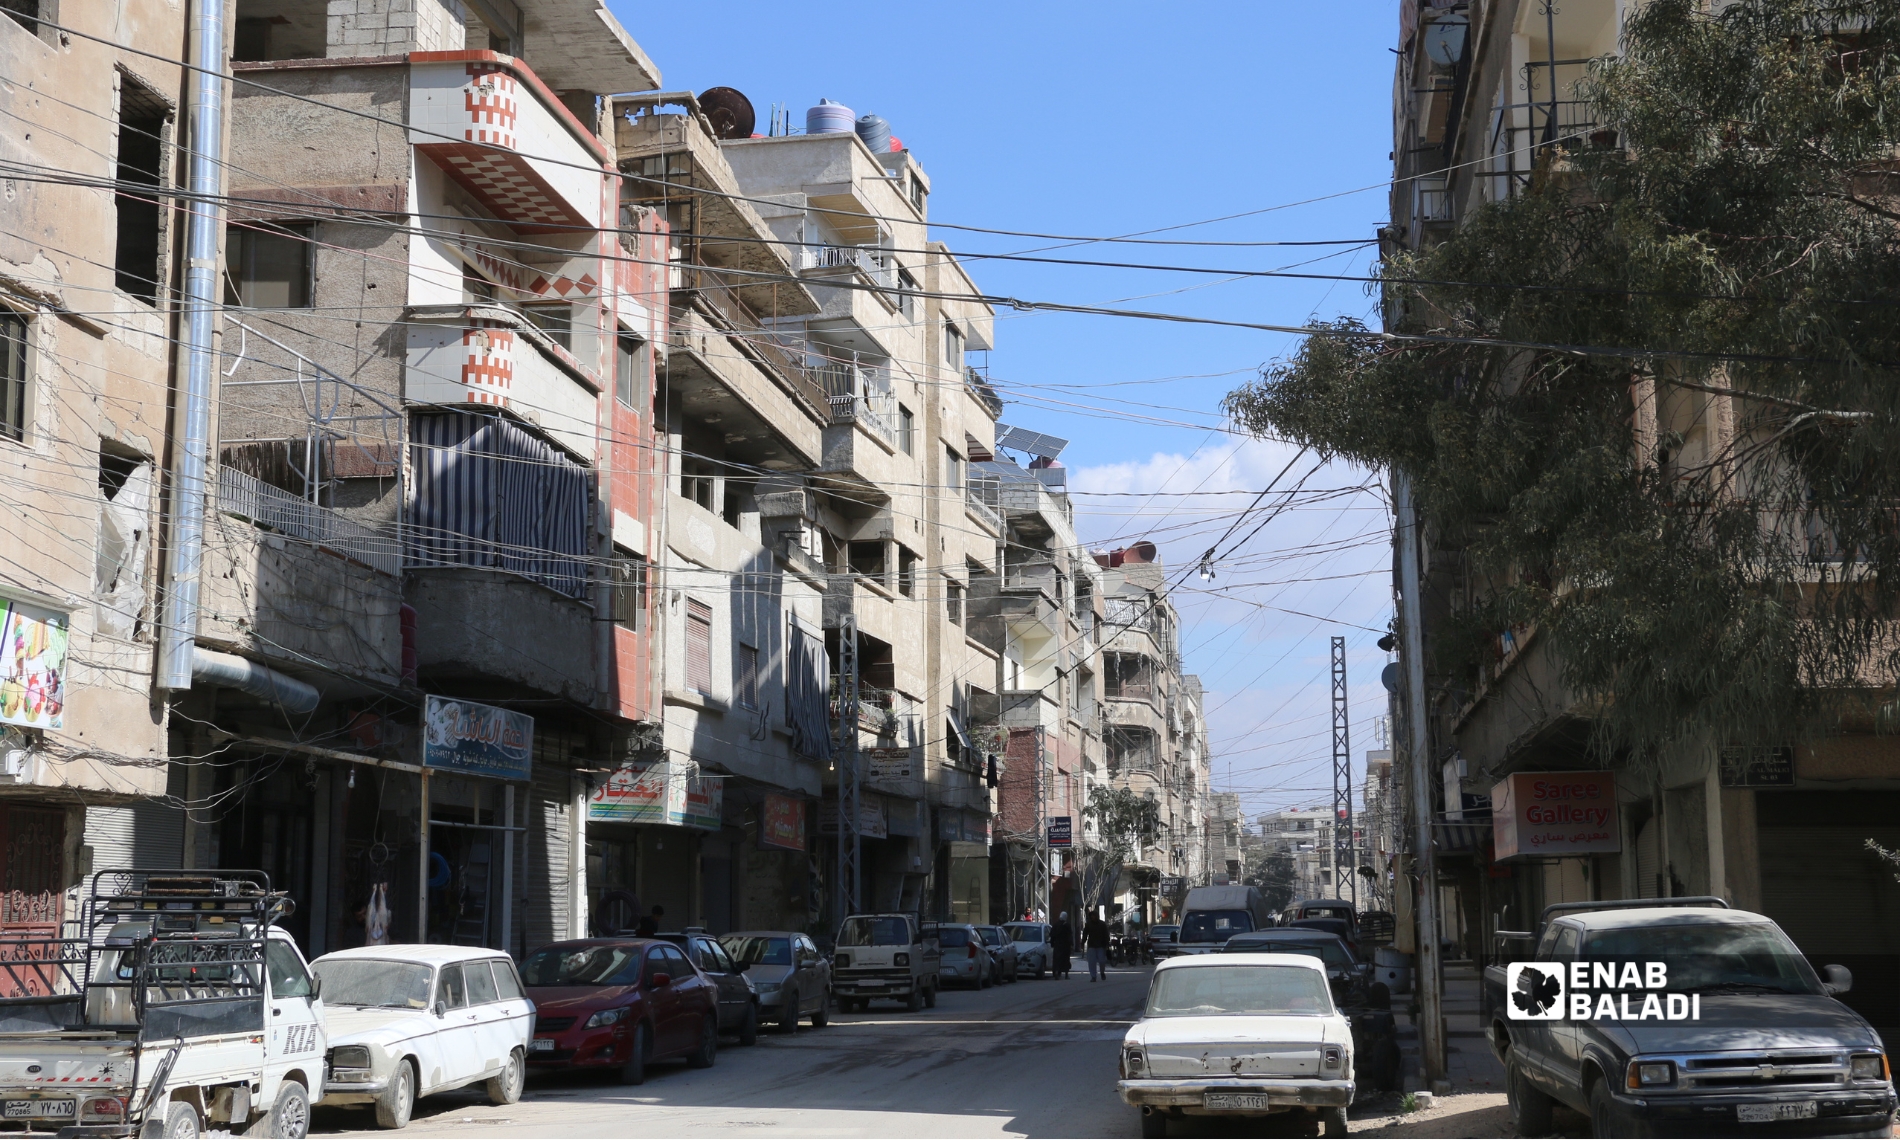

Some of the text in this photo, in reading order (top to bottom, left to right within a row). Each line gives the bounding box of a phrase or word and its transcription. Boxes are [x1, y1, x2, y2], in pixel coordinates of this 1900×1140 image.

[452, 706, 502, 752] الباشا
[592, 778, 663, 801] المختار
[1533, 780, 1600, 800] Saree
[1526, 804, 1610, 828] Gallery
[1531, 830, 1610, 847] معرض ساري
[283, 1024, 318, 1055] KIA
[6, 1100, 74, 1115] دمشق ٧٧٠٨٦٥
[1740, 1113, 1769, 1121] 226704
